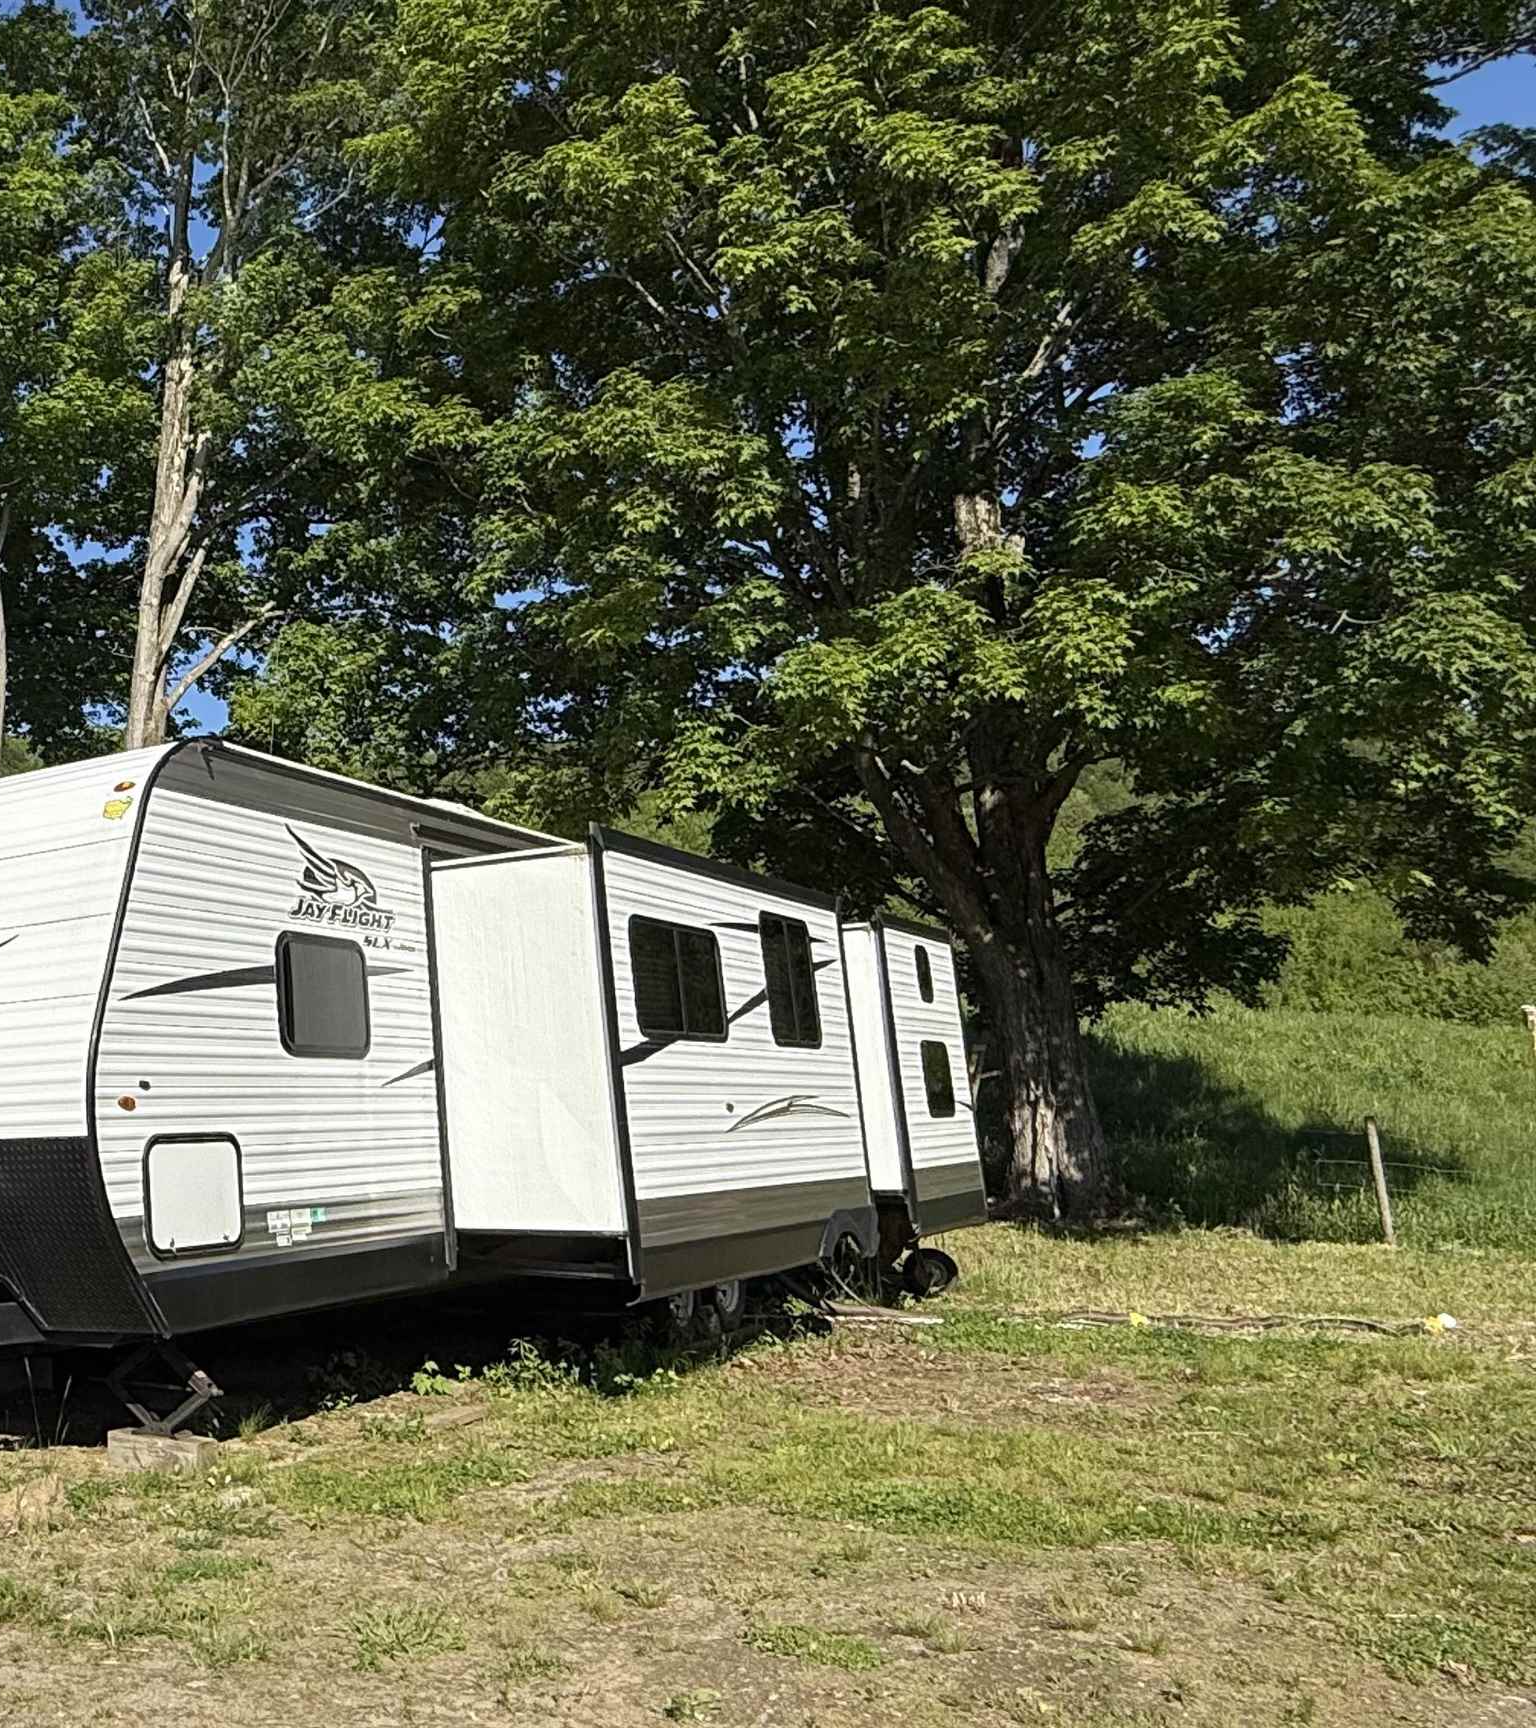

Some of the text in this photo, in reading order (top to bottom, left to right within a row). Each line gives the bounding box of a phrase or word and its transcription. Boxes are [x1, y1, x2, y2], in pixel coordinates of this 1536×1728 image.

[289, 896, 395, 932] JAY FLIGHT
[363, 935, 392, 950] SLX
